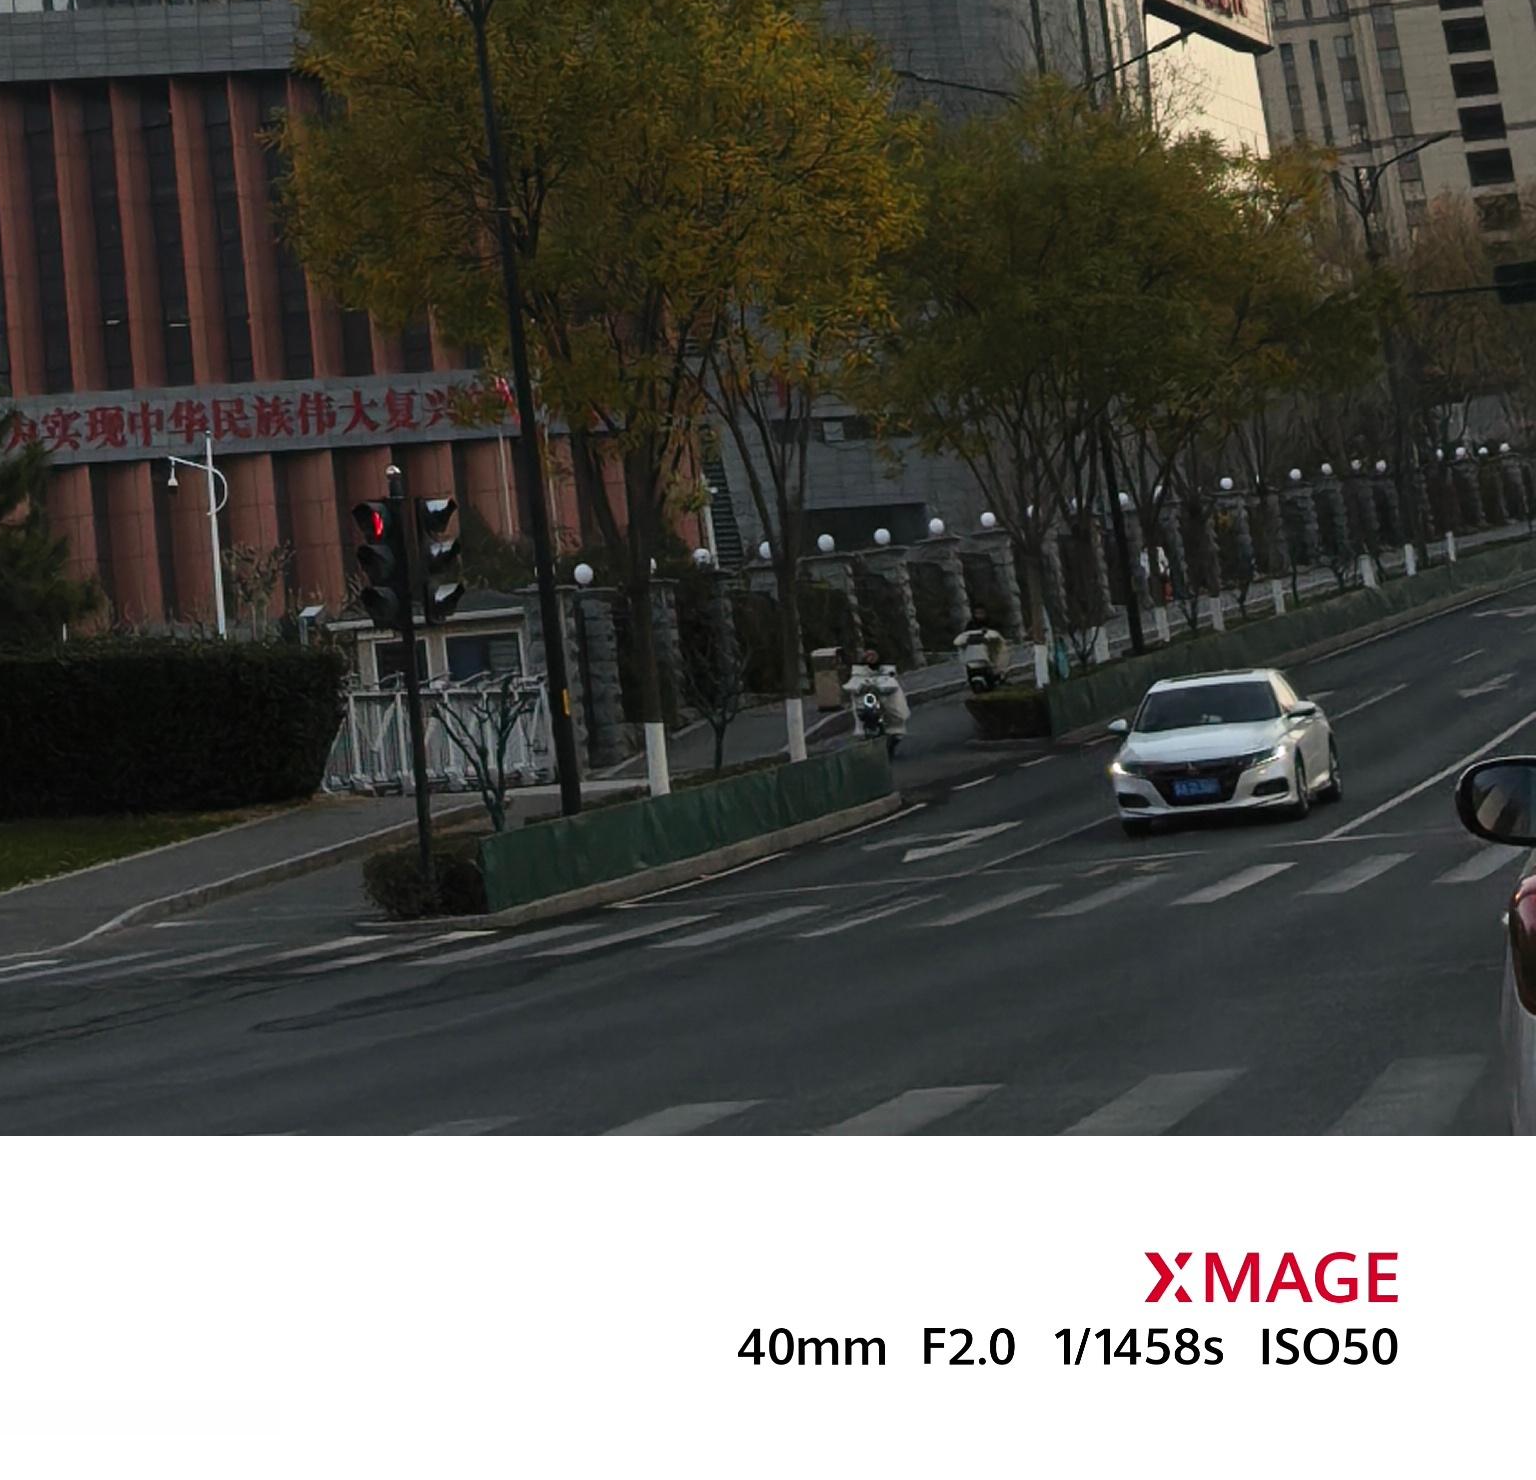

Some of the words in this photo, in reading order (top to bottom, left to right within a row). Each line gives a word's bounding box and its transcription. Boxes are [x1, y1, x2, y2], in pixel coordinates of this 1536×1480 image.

[3, 380, 499, 453] 为实现中华民族伟大复兴
